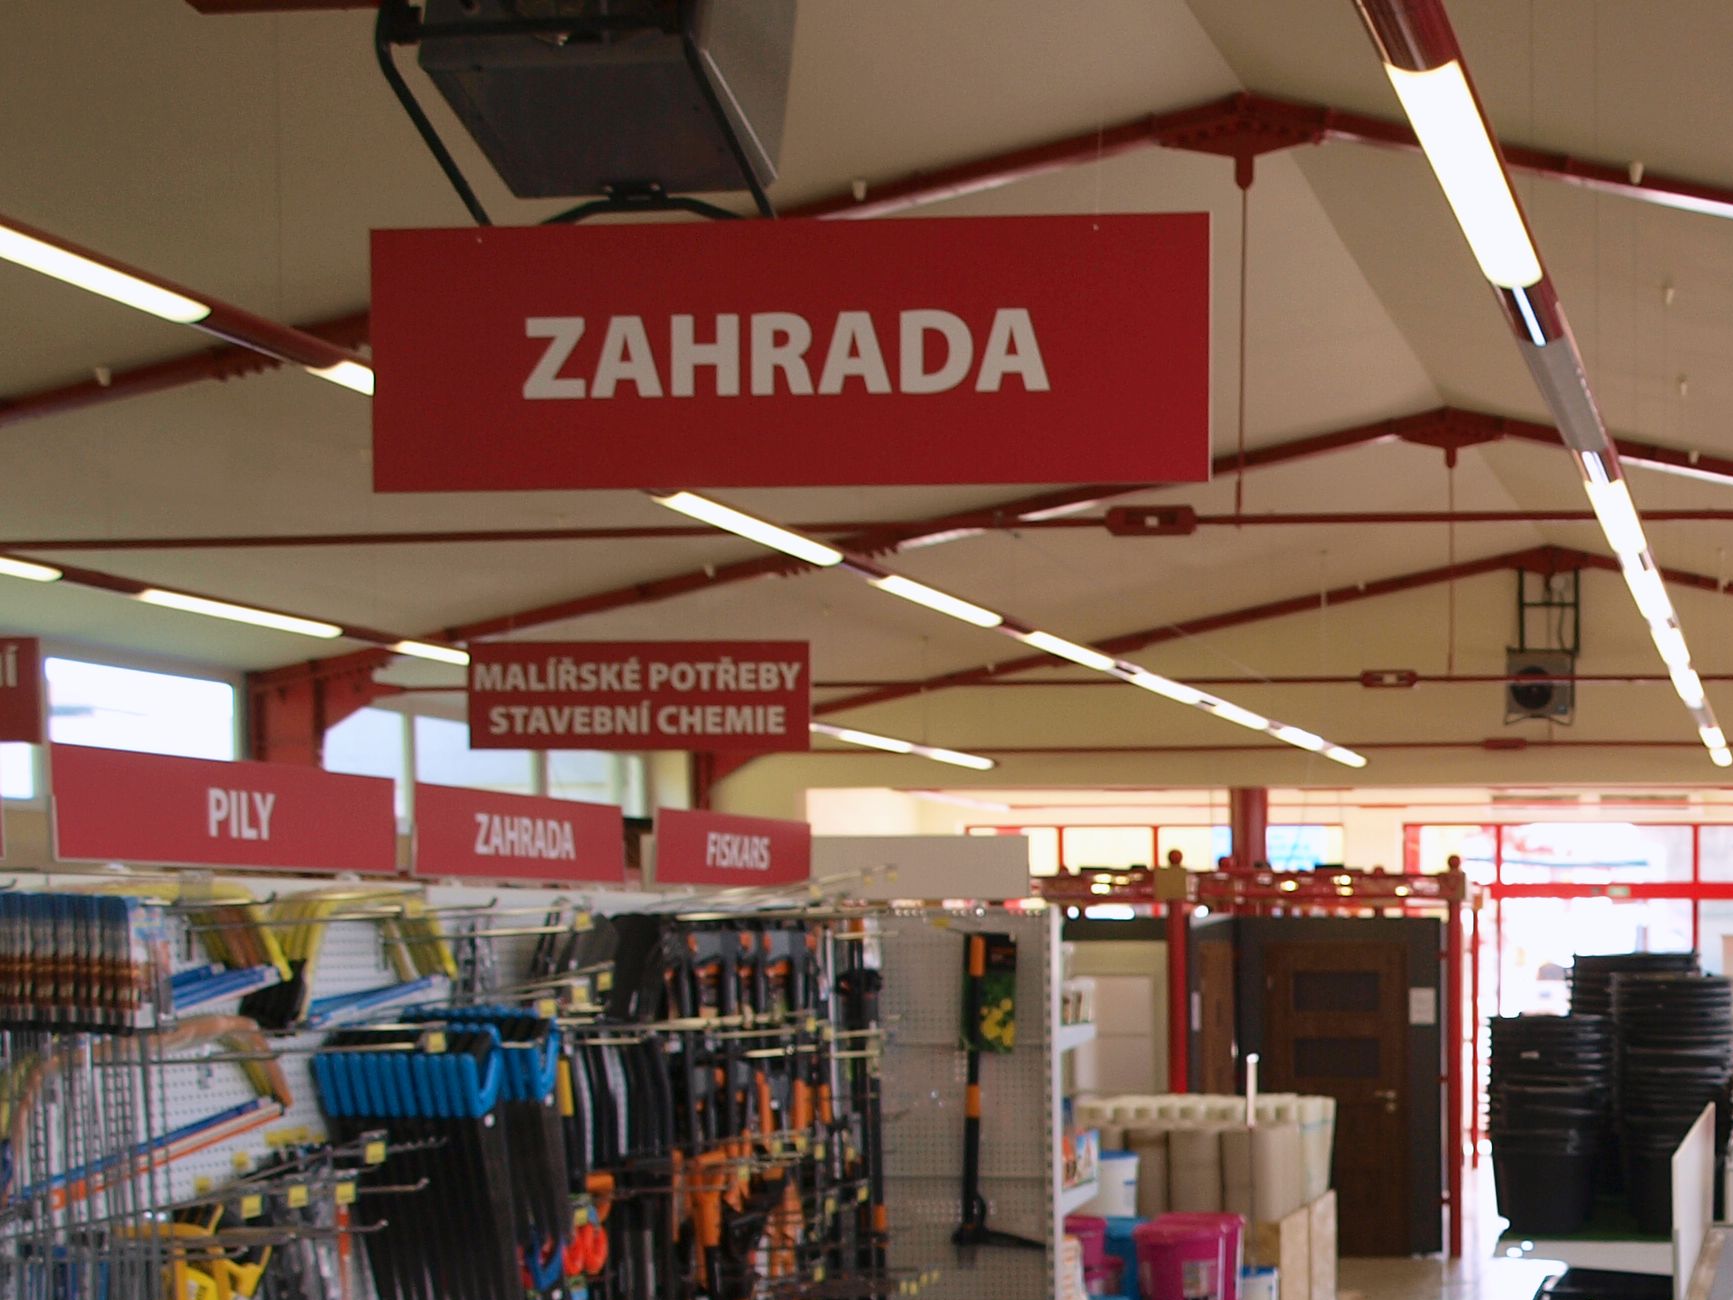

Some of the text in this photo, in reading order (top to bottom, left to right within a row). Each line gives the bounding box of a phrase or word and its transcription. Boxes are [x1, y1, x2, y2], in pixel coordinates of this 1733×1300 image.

[523, 308, 1050, 399] ZAHRADA
[474, 657, 801, 692] MALÍŘSKÉ POTŘEBY
[489, 700, 786, 735] STAVEBNÍ CHEMIE
[207, 787, 275, 841] PILY
[474, 812, 576, 862] ZAHRADA
[706, 831, 771, 871] FISKARS
